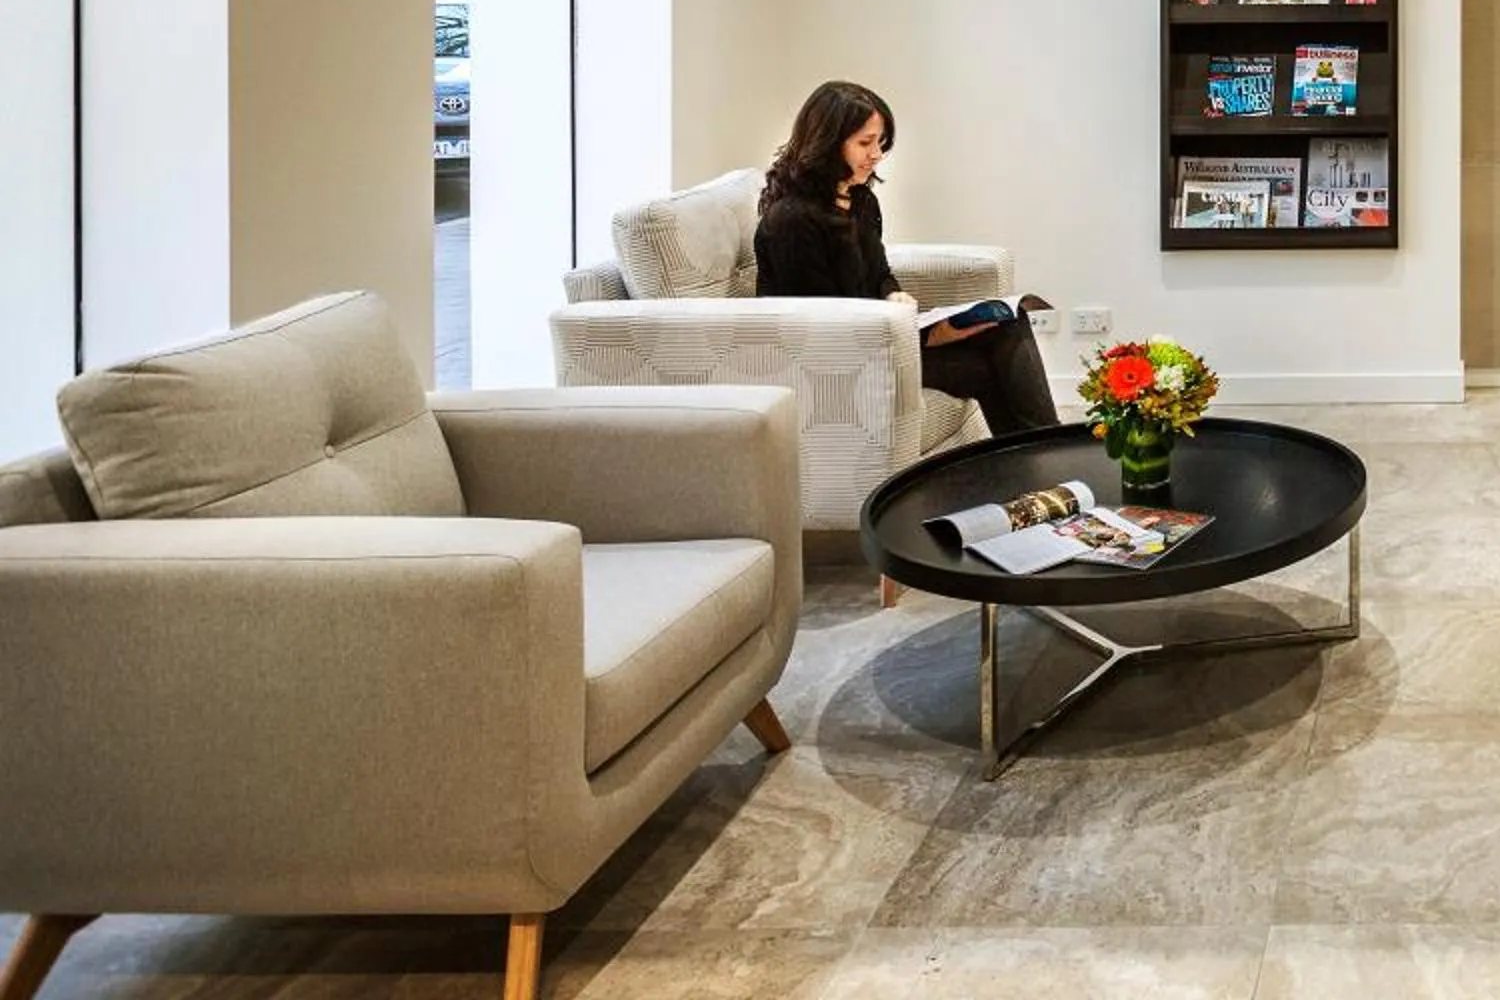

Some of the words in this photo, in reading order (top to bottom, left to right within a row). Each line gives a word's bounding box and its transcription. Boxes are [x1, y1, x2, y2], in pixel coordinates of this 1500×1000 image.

[1209, 75, 1273, 97] PROPERTY
[1225, 92, 1271, 113] SHARES
[1308, 188, 1349, 212] City
